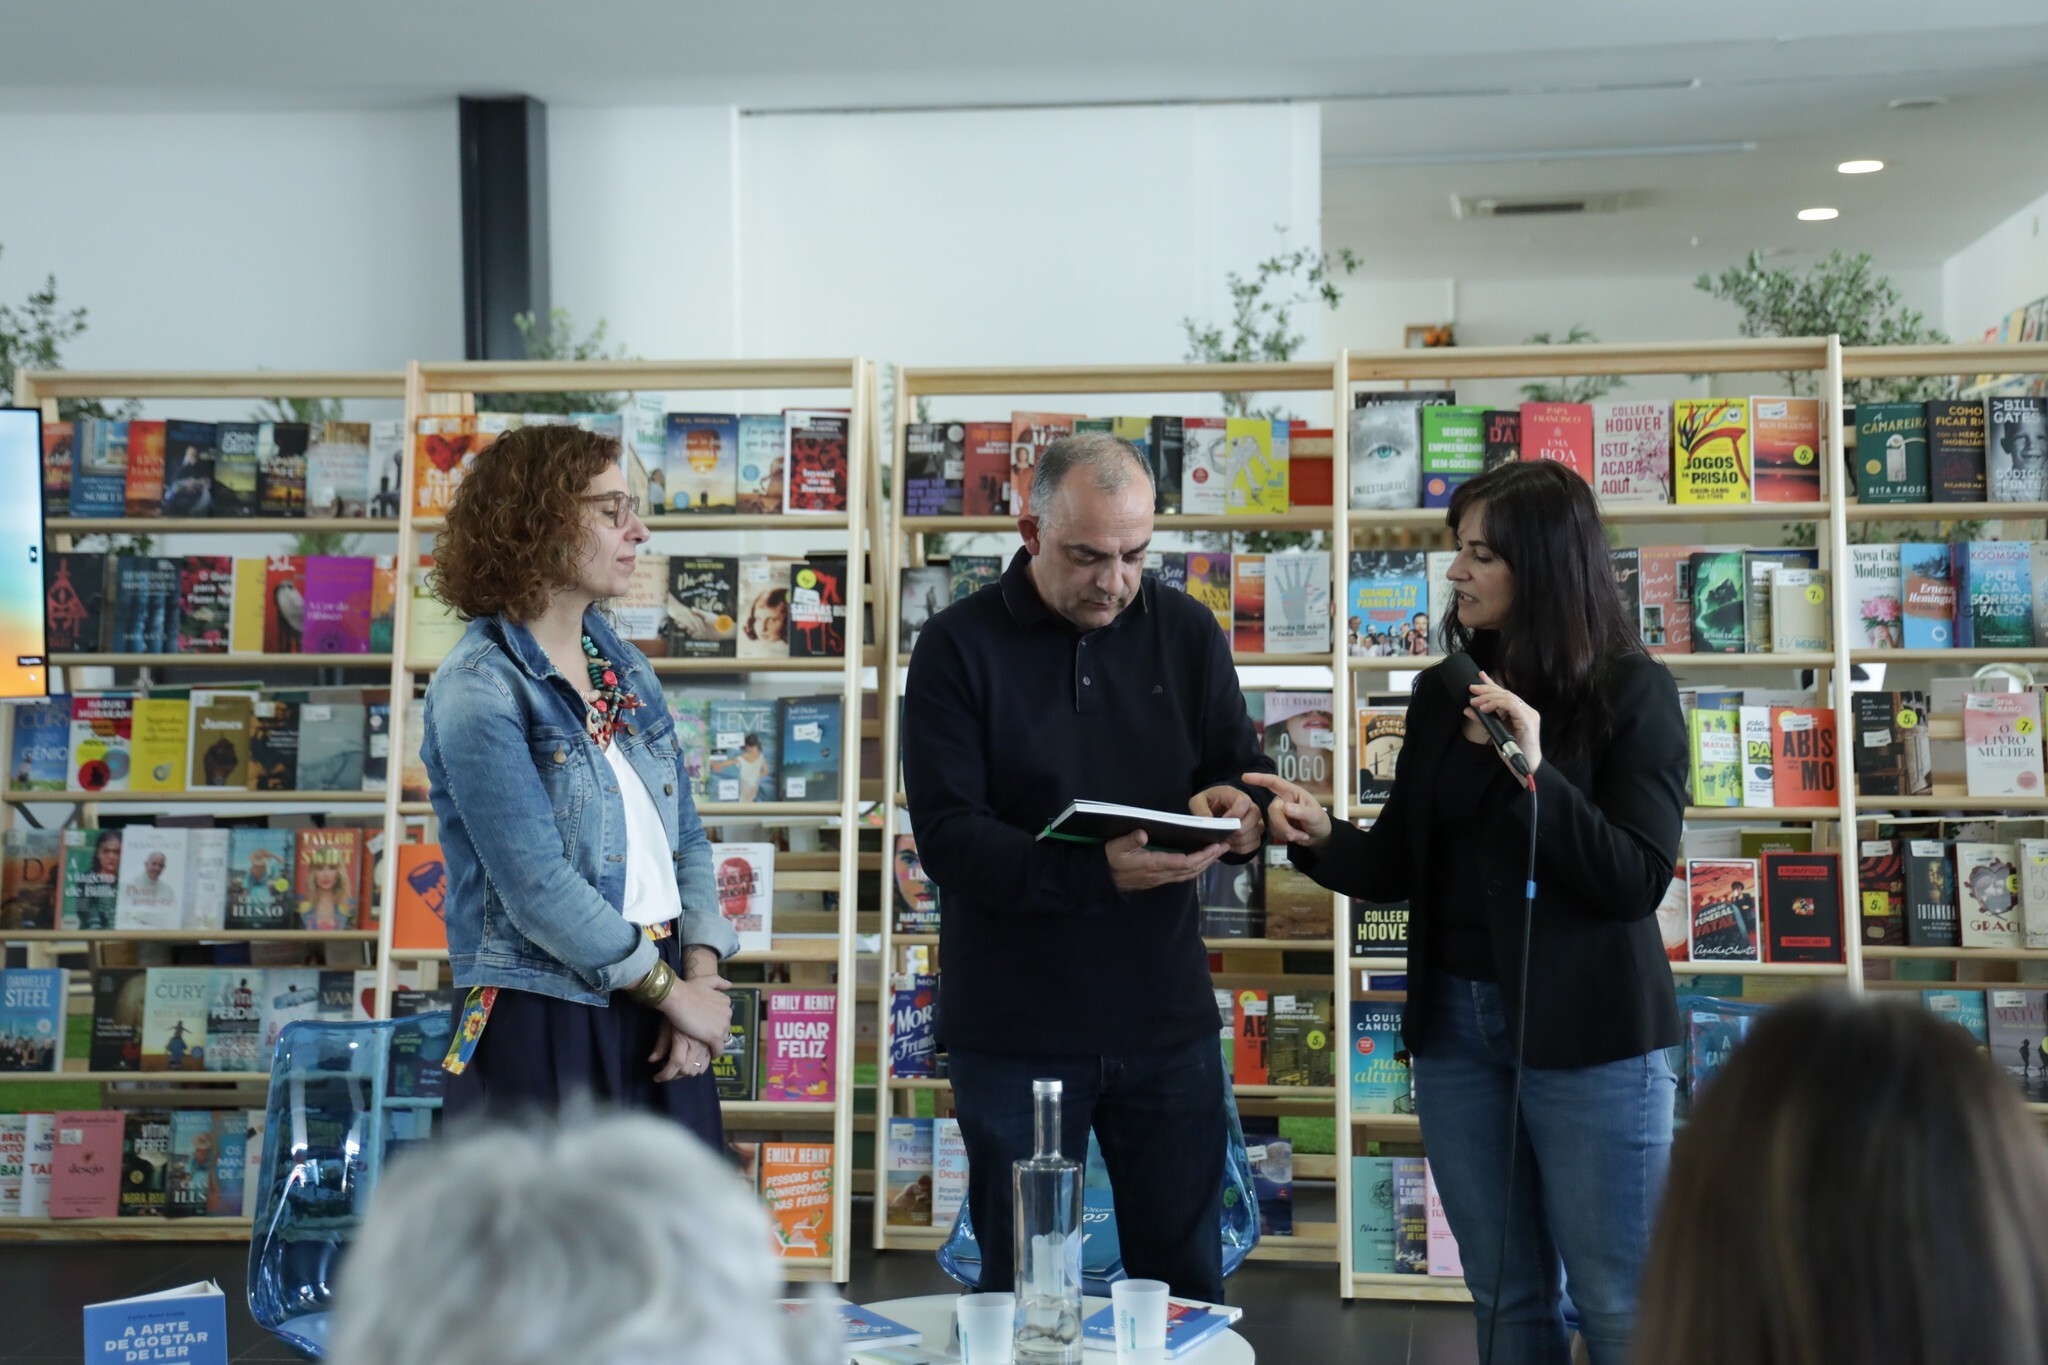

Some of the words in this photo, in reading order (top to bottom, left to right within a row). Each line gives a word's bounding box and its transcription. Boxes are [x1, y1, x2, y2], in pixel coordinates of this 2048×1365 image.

[1546, 407, 1569, 415] PAPA
[1611, 405, 1655, 418] COLLEEN
[1948, 405, 1983, 417] COMO
[1533, 415, 1582, 424] FRANCISCO
[1605, 416, 1662, 433] HOOVER
[1935, 416, 1969, 428] FICAR
[1993, 412, 2041, 424] GATES
[1441, 427, 1478, 438] SEGREDOS
[1547, 439, 1568, 447] UMA
[1540, 448, 1577, 463] BOA
[1600, 442, 1629, 458] ISTO
[1600, 459, 1642, 476] ACABA
[1684, 456, 1735, 471] JOGOS
[1691, 471, 1740, 485] PRISÃO
[1995, 466, 2043, 480] CÓDIGO
[1600, 478, 1631, 495] AQUI
[1868, 485, 1892, 496] NITA
[1944, 482, 1970, 490] RICARDO
[1852, 548, 1879, 562] Sveva
[1970, 551, 2030, 562] KOOMSON
[1651, 562, 1659, 572] O
[1985, 570, 2017, 581] POR
[1360, 588, 1394, 598] QUANDO
[1396, 588, 1402, 597] A
[1404, 585, 1418, 598] TV
[1980, 581, 2021, 594] CADA
[1357, 598, 1389, 608] PARAVA
[1390, 598, 1397, 607] O
[1970, 594, 2032, 606] SORRISO
[1979, 605, 2025, 617] FALSO
[1268, 624, 1296, 633] LEITURA
[1297, 624, 1306, 632] DE
[1307, 621, 1326, 632] MÃOS
[1297, 630, 1318, 638] TODOS
[1272, 697, 1290, 707] ELLE
[201, 718, 243, 730] James
[716, 711, 772, 732] LEME
[1375, 719, 1404, 729] LORD
[1746, 718, 1764, 727] JOÃO
[1999, 723, 2010, 734] O
[1279, 732, 1290, 753] O
[1702, 742, 1732, 750] MATAR
[1782, 727, 1835, 759] ABIS
[1984, 736, 2027, 747] LIVRO
[1978, 747, 2036, 758] MULHER
[1801, 760, 1836, 791] MO
[303, 832, 354, 846] TAYLOR
[1364, 911, 1410, 924] COLLEEN
[1694, 906, 1734, 928] FUNERAL
[1357, 924, 1408, 941] HOOVE
[1695, 916, 1737, 939] FATAL
[1693, 944, 1726, 957] Agatha
[7, 975, 52, 988] DANIELLE
[155, 984, 205, 999] CURY
[5, 989, 51, 1008] STEEL
[771, 995, 802, 1011] EMILY
[803, 995, 836, 1011] HENRY
[774, 1022, 830, 1041] LUGAR
[1722, 1035, 1732, 1050] A
[777, 1040, 826, 1059] FELIZ
[1372, 1058, 1408, 1071] nas
[766, 1147, 797, 1163] EMILY
[799, 1147, 832, 1163] HENRY
[939, 1158, 952, 1167] de
[766, 1171, 809, 1186] PESSOAS
[939, 1170, 966, 1179] Deus
[774, 1197, 795, 1211] NAS
[123, 1326, 137, 1338] A
[141, 1321, 191, 1337] ARTE
[105, 1339, 130, 1352] DE
[134, 1332, 208, 1349] GOSTAR
[126, 1349, 150, 1362] DE
[154, 1345, 189, 1359] LER
